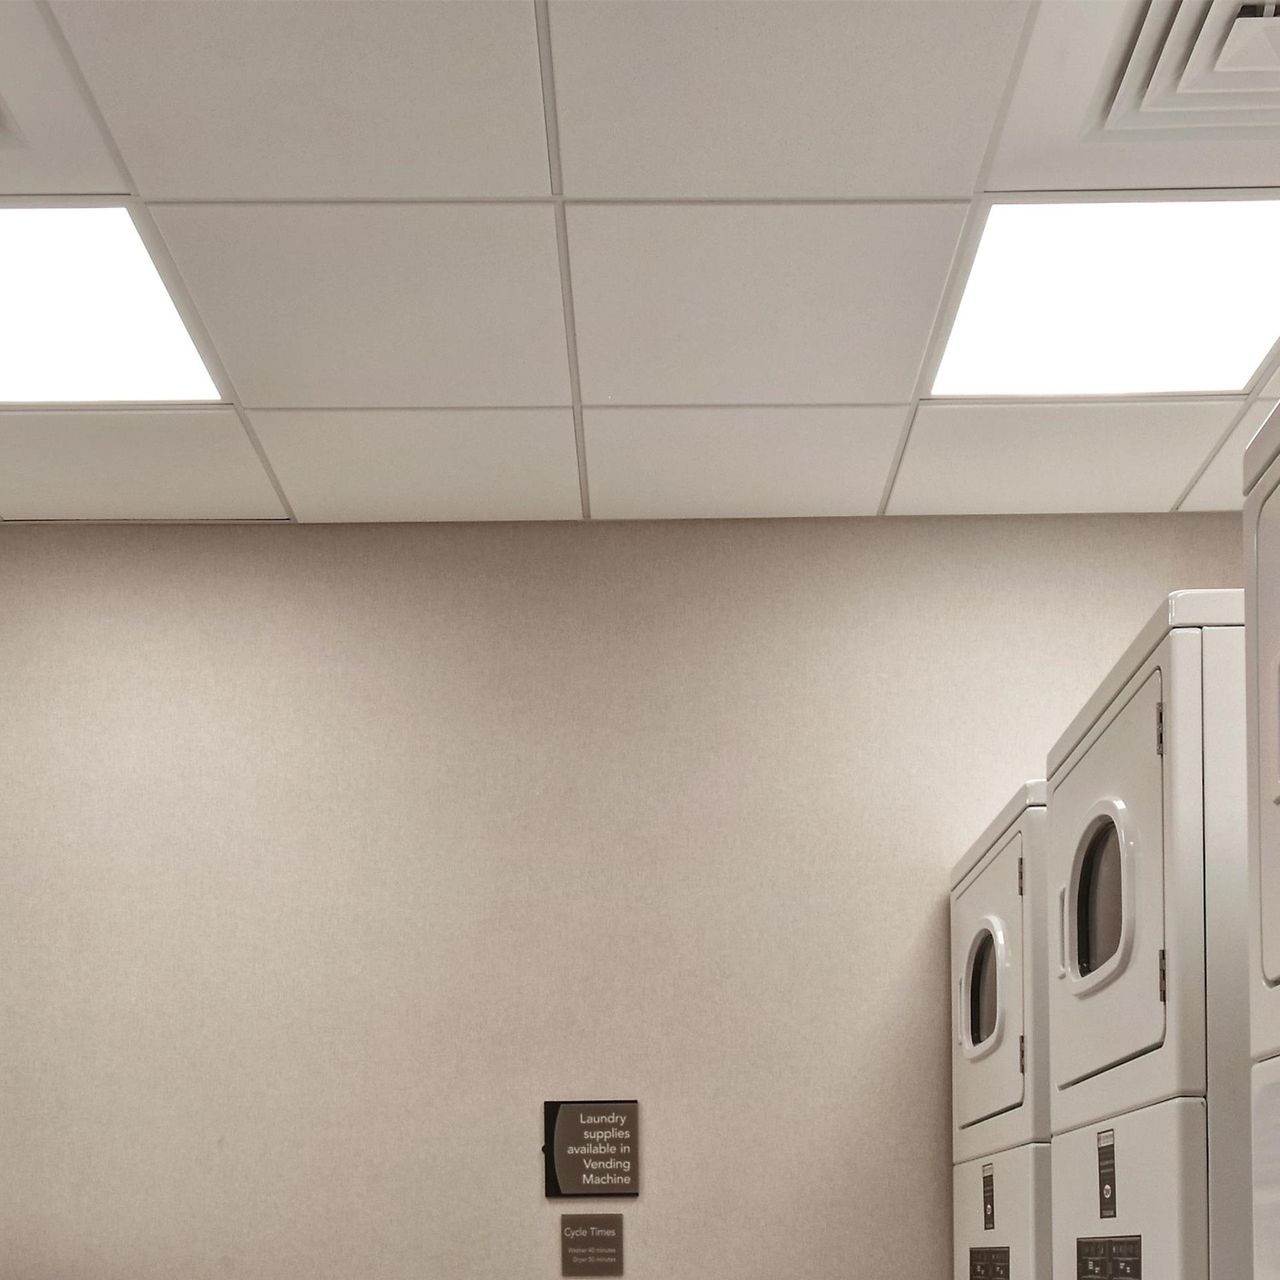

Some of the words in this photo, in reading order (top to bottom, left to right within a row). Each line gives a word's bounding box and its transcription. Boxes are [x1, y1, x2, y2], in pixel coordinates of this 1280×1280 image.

[580, 1112, 627, 1126] Laundry
[583, 1128, 630, 1142] supplies
[567, 1143, 616, 1154] available
[620, 1143, 630, 1154] in
[583, 1158, 631, 1172] Vending
[582, 1173, 631, 1185] Machine
[564, 1227, 588, 1239] Cycle
[590, 1227, 616, 1237] Times
